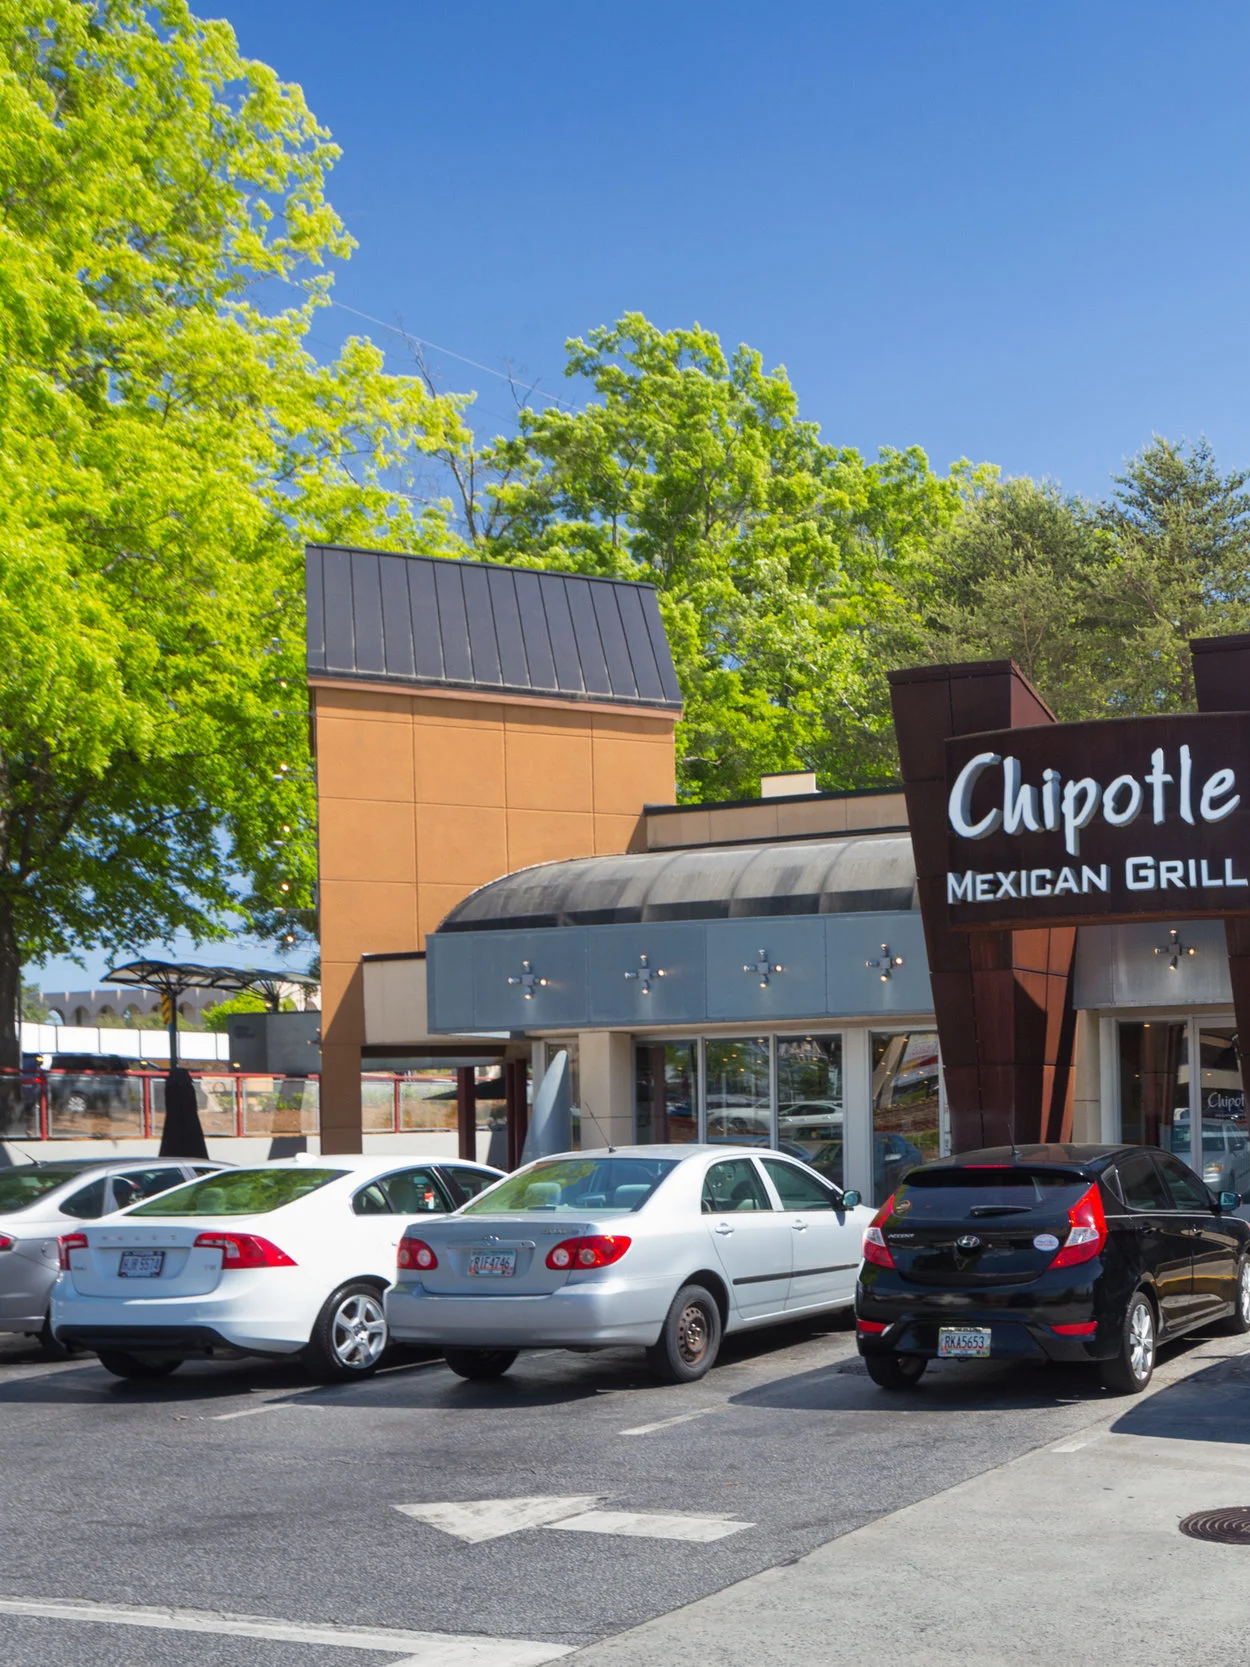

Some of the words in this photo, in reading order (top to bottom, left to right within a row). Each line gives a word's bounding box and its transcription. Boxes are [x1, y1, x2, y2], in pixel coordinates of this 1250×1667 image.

[948, 744, 1241, 857] Chipotle
[947, 863, 1111, 905] MEXICAN
[1125, 856, 1249, 890] GRILL
[944, 1335, 985, 1349] RKA5653
